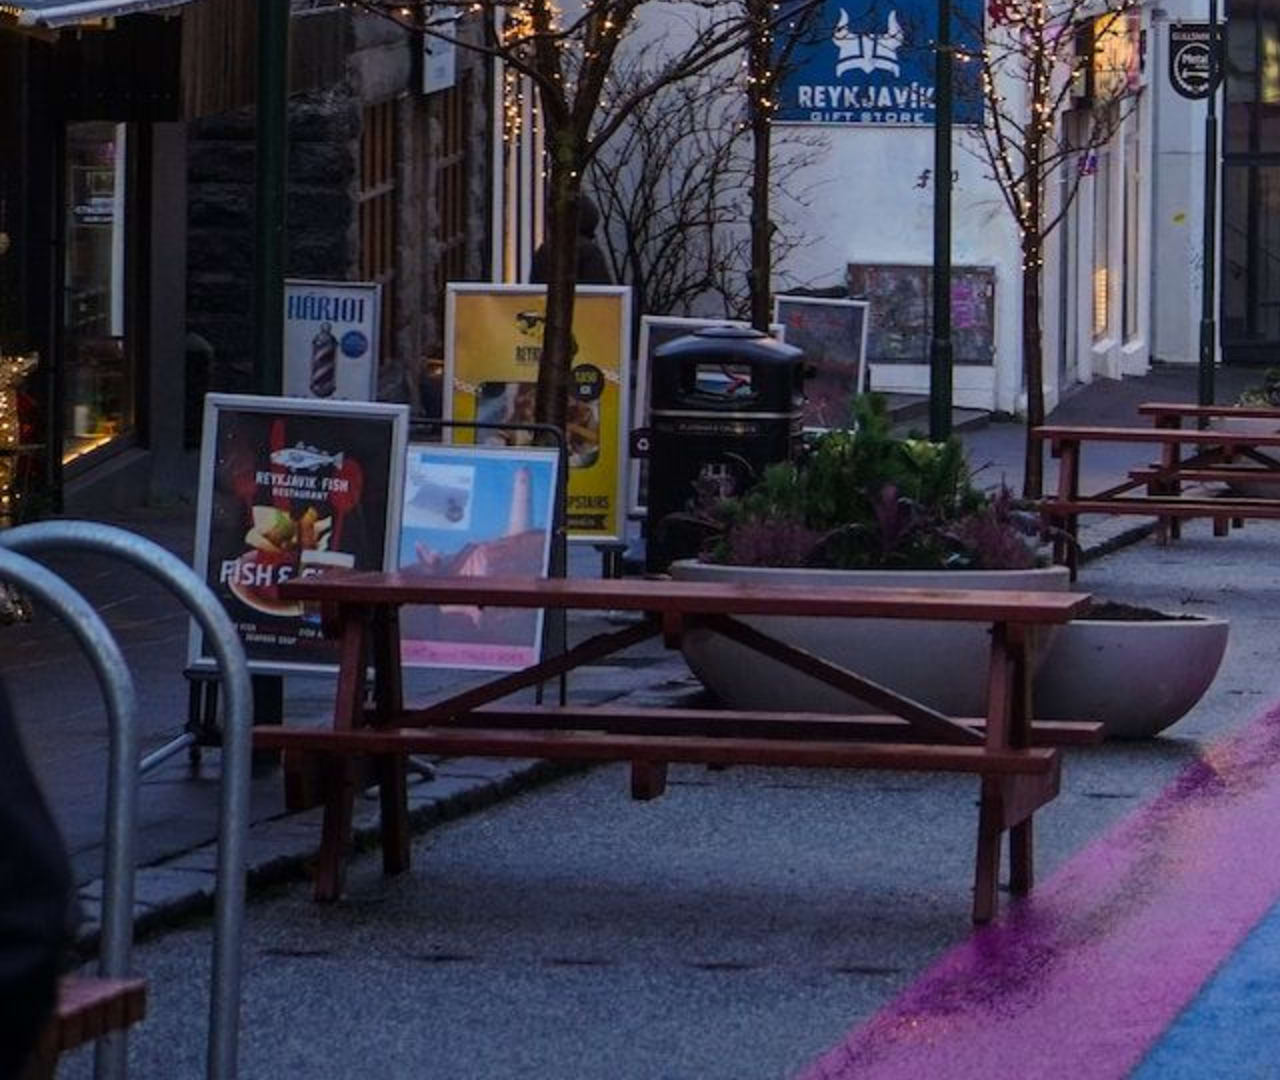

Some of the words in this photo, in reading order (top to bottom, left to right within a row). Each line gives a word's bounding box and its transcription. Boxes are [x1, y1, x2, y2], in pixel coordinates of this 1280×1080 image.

[810, 111, 852, 123] GIFT
[861, 112, 925, 124] STORE
[321, 477, 349, 493] FISH
[271, 487, 329, 501] RESTAURANT
[220, 559, 272, 587] FISH
[277, 567, 292, 584] &
